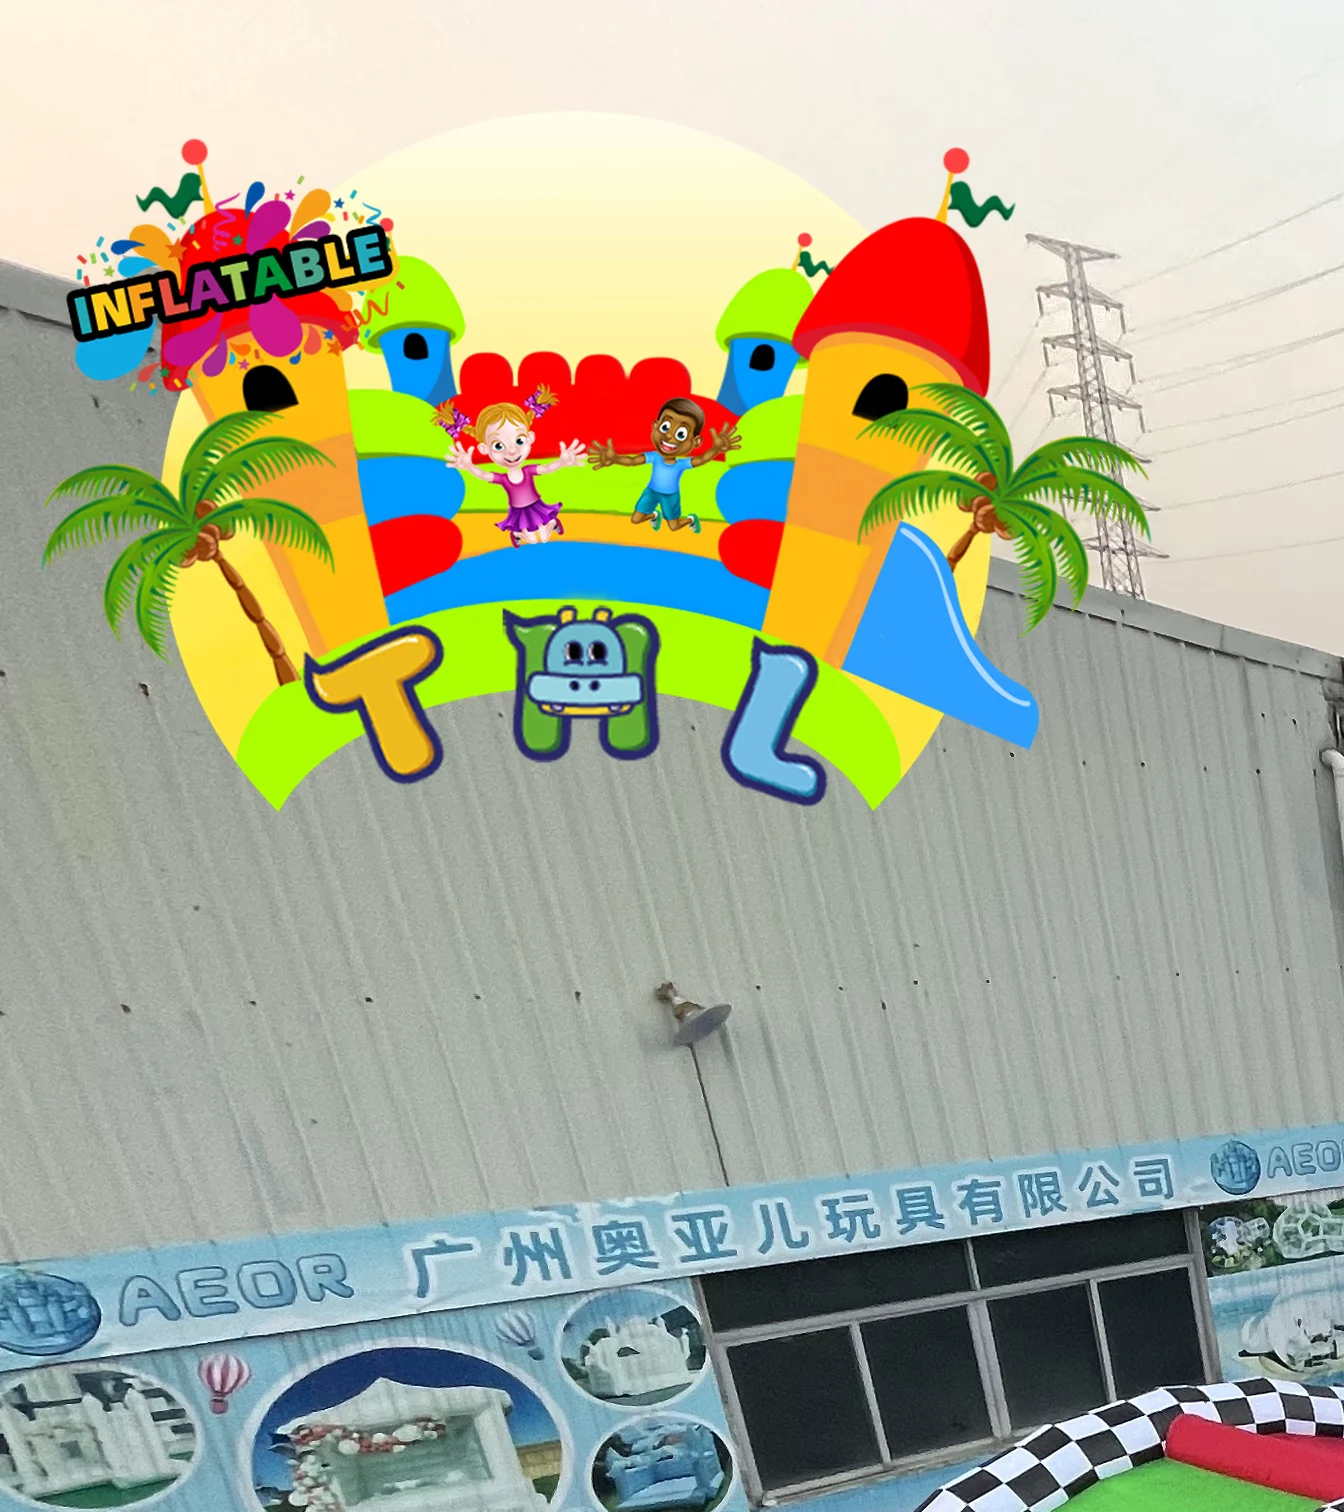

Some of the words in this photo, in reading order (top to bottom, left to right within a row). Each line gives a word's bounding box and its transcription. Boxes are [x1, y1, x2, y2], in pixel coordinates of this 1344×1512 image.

[408, 1155, 1176, 1300] 广州奥亚儿玩具有限公司
[119, 1252, 355, 1327] AEOR
